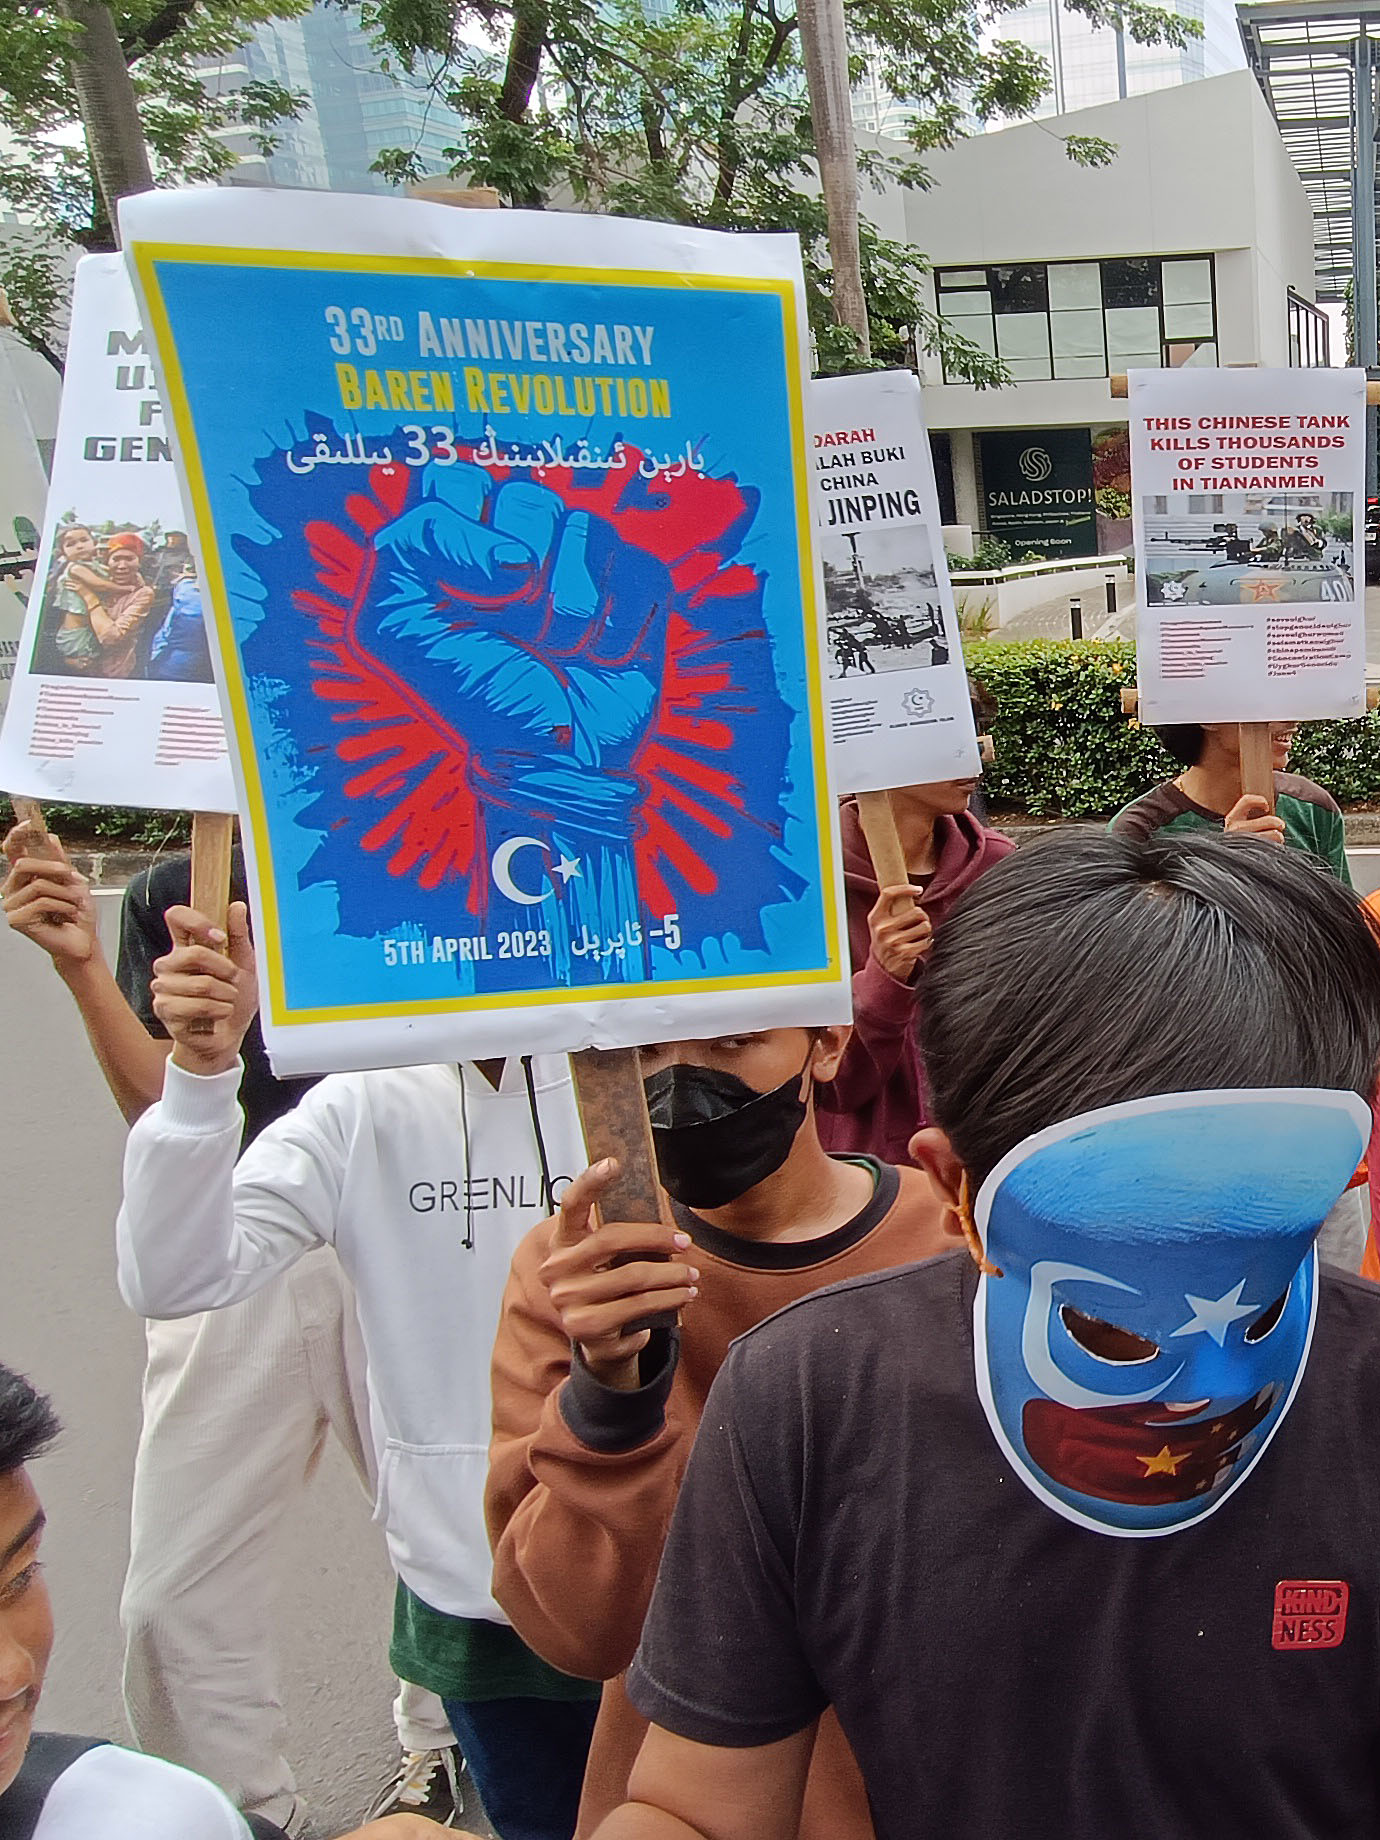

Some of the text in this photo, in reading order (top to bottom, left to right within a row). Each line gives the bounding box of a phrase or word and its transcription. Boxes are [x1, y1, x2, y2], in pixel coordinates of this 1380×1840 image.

[1143, 415, 1350, 430] THIS CHINESE TANK
[402, 424, 459, 467] 33
[1150, 436, 1345, 451] KILLS THOUSANDS
[816, 446, 906, 470] LAH BUKI
[1178, 456, 1319, 471] OF STUDENTS
[820, 472, 879, 491] CHINA
[1173, 476, 1324, 490] IN TIANANMEN
[828, 489, 921, 526] JINPING
[988, 488, 1092, 507] SALADSTOP!
[497, 930, 551, 959] 2023
[1283, 1588, 1340, 1614] KIND
[1280, 1619, 1336, 1643] NESS
